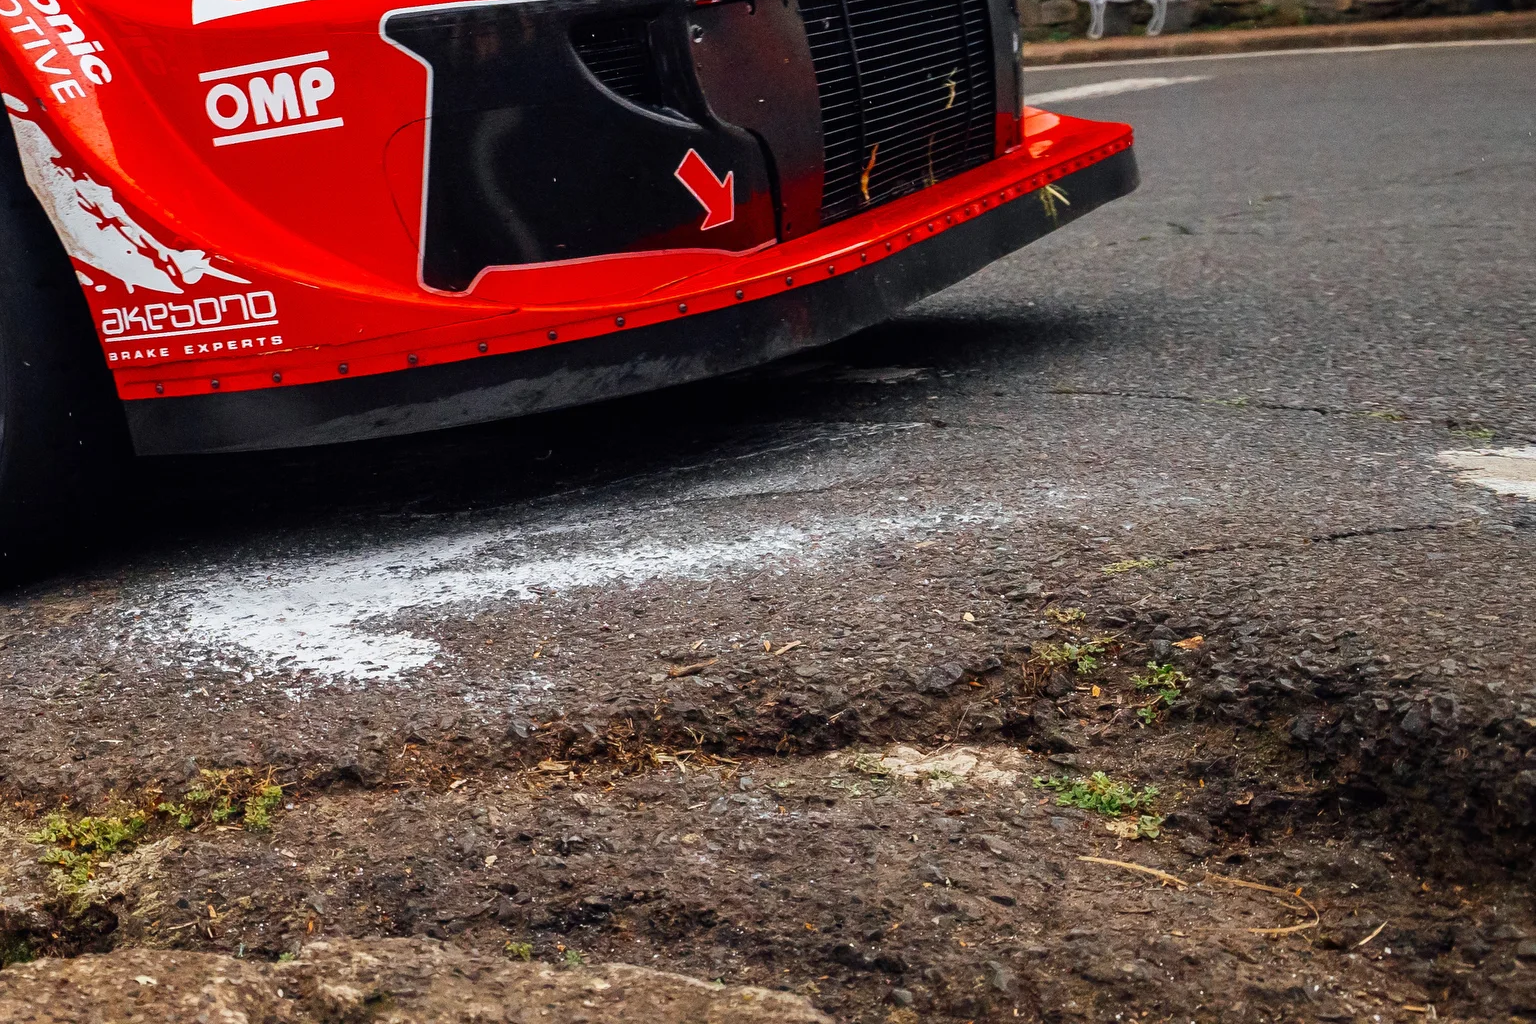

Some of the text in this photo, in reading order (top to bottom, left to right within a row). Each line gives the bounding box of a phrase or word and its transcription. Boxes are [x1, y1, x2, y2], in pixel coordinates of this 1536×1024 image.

[205, 66, 336, 130] OMP
[102, 290, 277, 336] akebono
[108, 334, 284, 362] BRAKE EXPERTS
